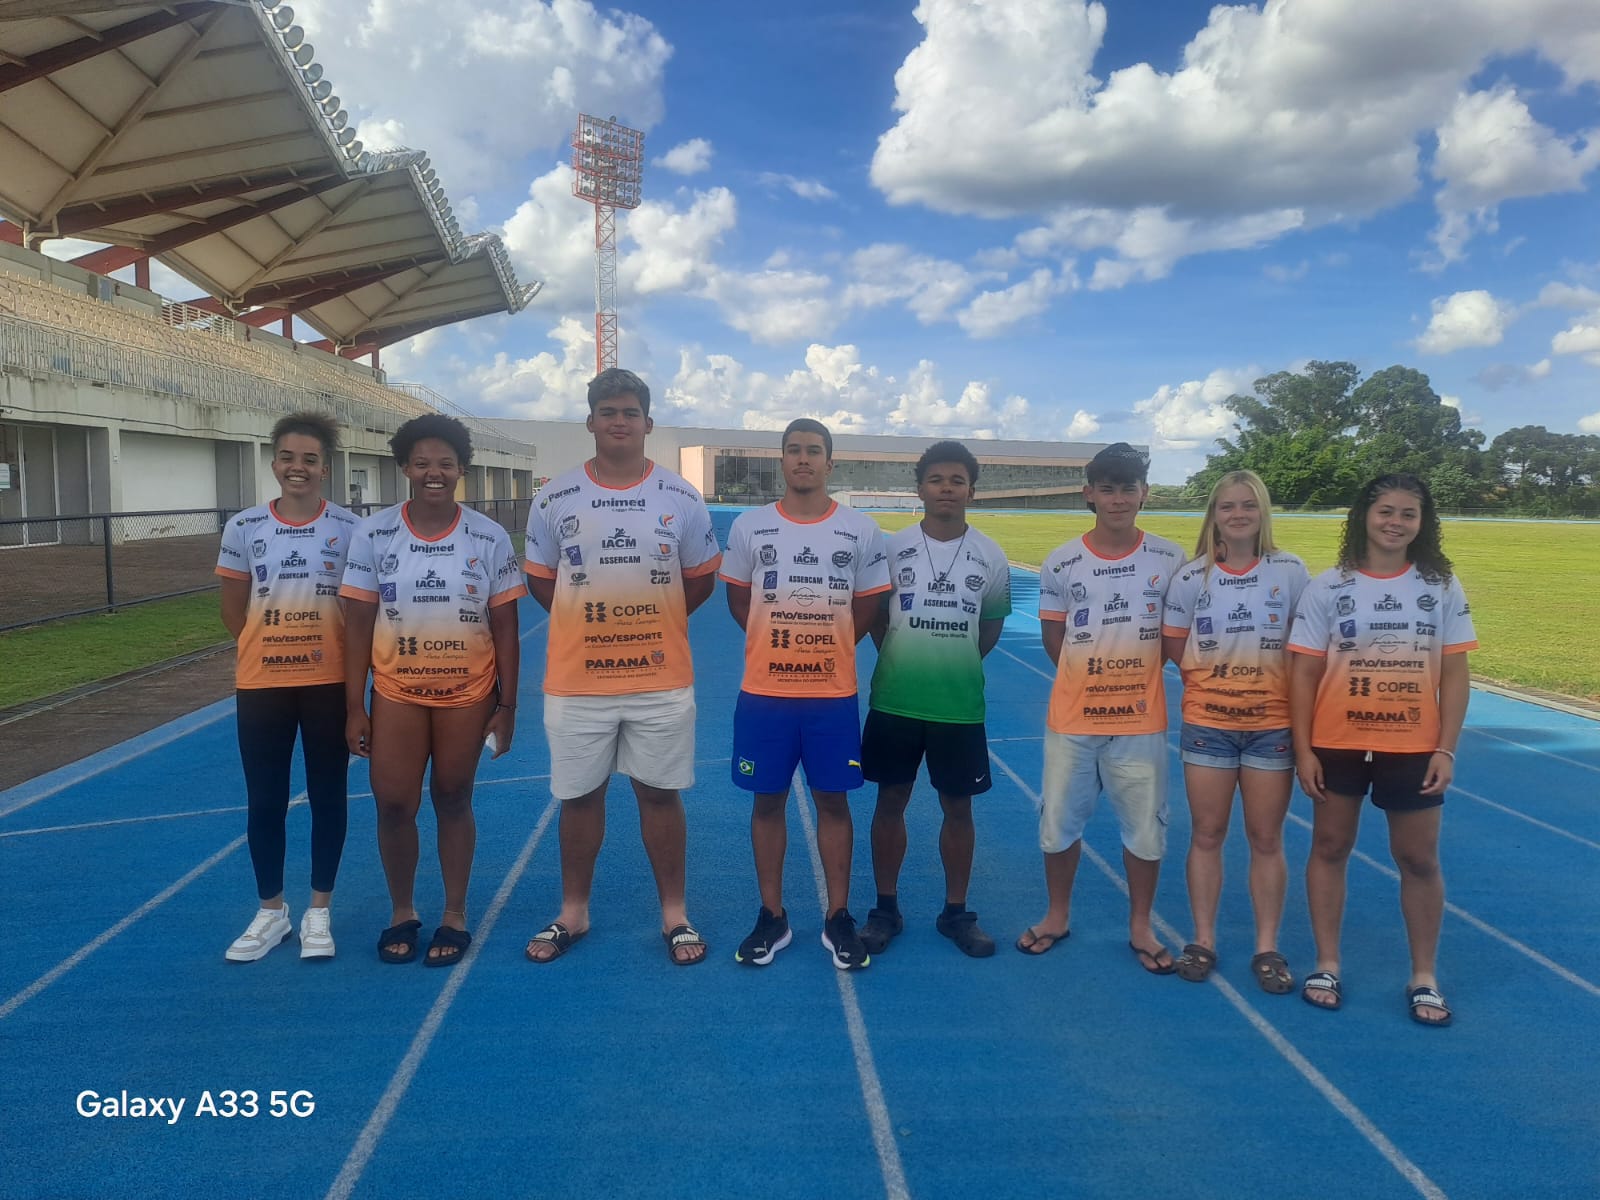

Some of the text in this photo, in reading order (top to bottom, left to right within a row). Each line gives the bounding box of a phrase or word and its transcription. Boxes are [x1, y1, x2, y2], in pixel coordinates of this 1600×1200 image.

[548, 485, 580, 502] Paraná
[666, 486, 698, 502] integrado
[592, 497, 645, 508] Unimed
[276, 527, 315, 535] Unimed
[602, 538, 636, 548] IACM
[410, 544, 454, 553] Unimed
[281, 559, 306, 567] IACM
[600, 555, 640, 565] ASSERCAM
[794, 555, 818, 564] IACM
[1093, 564, 1135, 577] Unimed
[416, 580, 446, 588] IACM
[1219, 575, 1258, 586] Unimed
[928, 582, 955, 592] IACM
[924, 599, 957, 608] ASSERCAM
[1104, 602, 1128, 611] IACM
[613, 604, 660, 617] COPEL
[1228, 611, 1252, 620] IACM
[284, 611, 322, 621] COPEL
[909, 616, 968, 631] Unimed
[795, 634, 836, 645] COPEL
[424, 640, 468, 650] COPEL
[585, 655, 650, 668] PARANÁ
[1107, 658, 1144, 669] COPEL
[769, 662, 822, 672] PARANÁ
[1377, 682, 1422, 693] COPEL
[1347, 710, 1407, 721] PARANÁ
